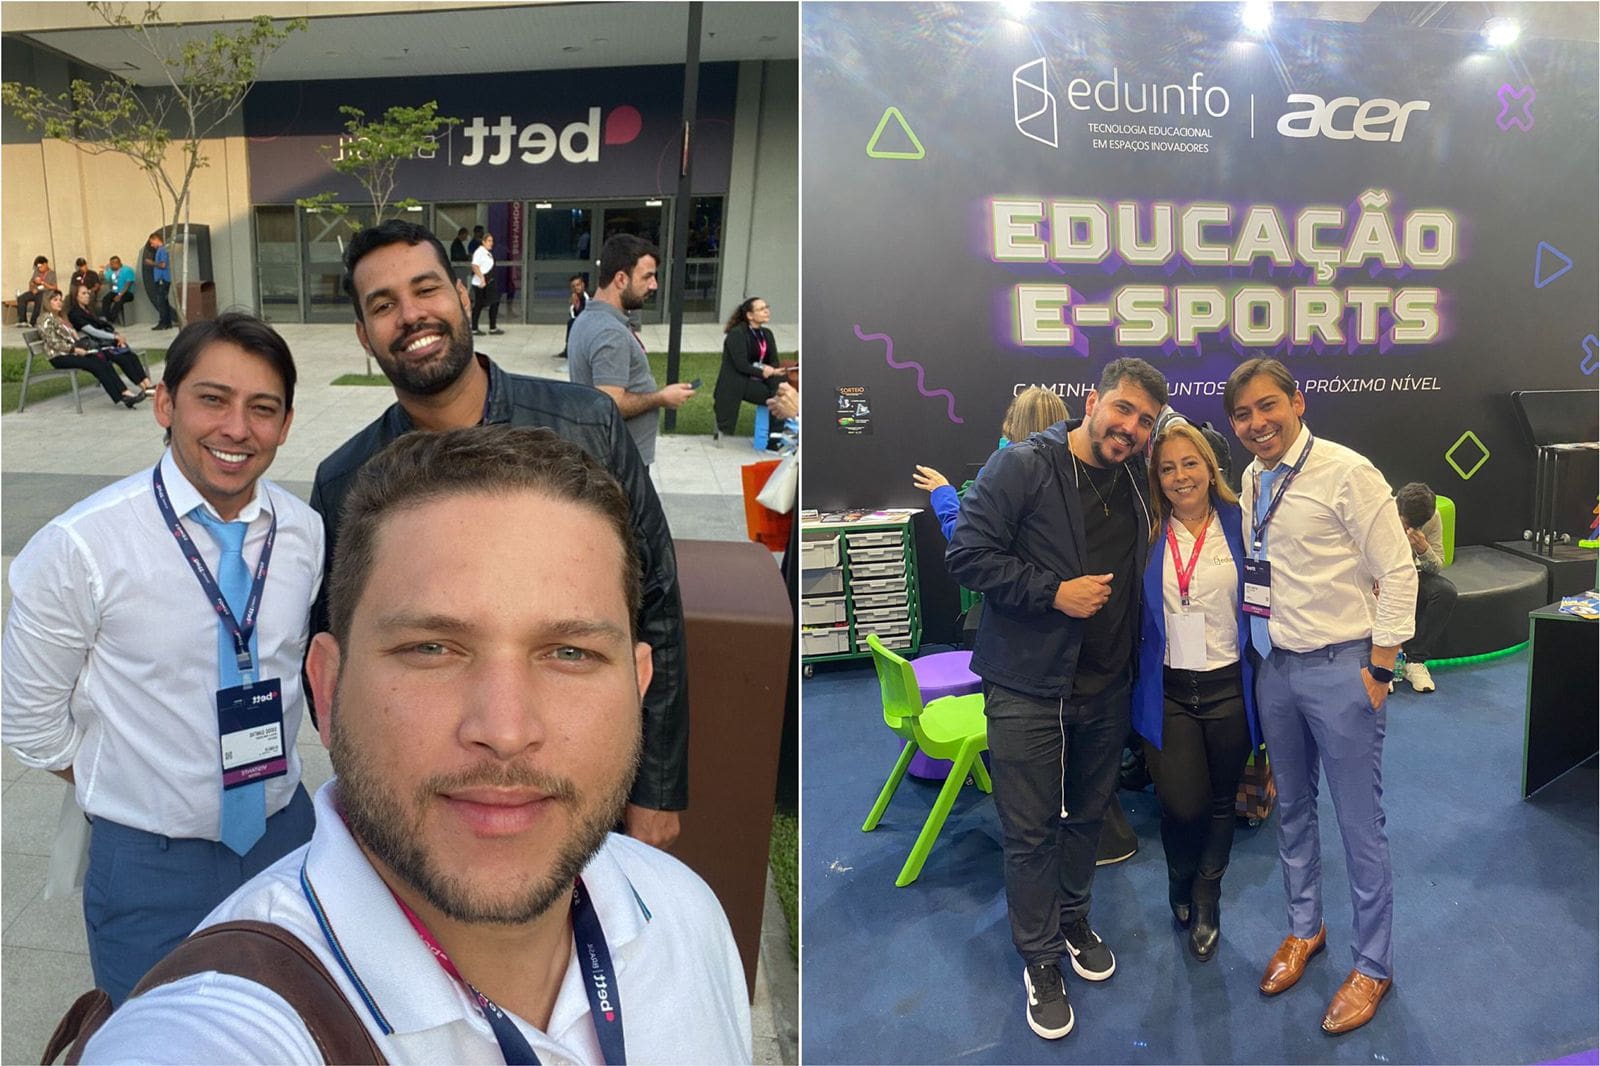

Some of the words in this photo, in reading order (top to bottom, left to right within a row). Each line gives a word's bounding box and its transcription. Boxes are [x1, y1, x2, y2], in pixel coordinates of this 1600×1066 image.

[1067, 67, 1230, 118] eduinfo
[1087, 122, 1148, 135] TECNOLOGIA
[1148, 126, 1213, 138] EDUCACIONAL
[1276, 93, 1431, 143] acer
[1092, 138, 1108, 149] EM
[1109, 139, 1150, 152] ESPAÇOS
[1151, 142, 1209, 153] INOVADORES
[992, 189, 1456, 283] EDUCAÇÃO
[1016, 285, 1440, 346] E-SPORTS
[1166, 381, 1228, 396] UNTOS
[1305, 375, 1386, 393] PRÓXIMO
[1390, 374, 1441, 391] NÍVEL
